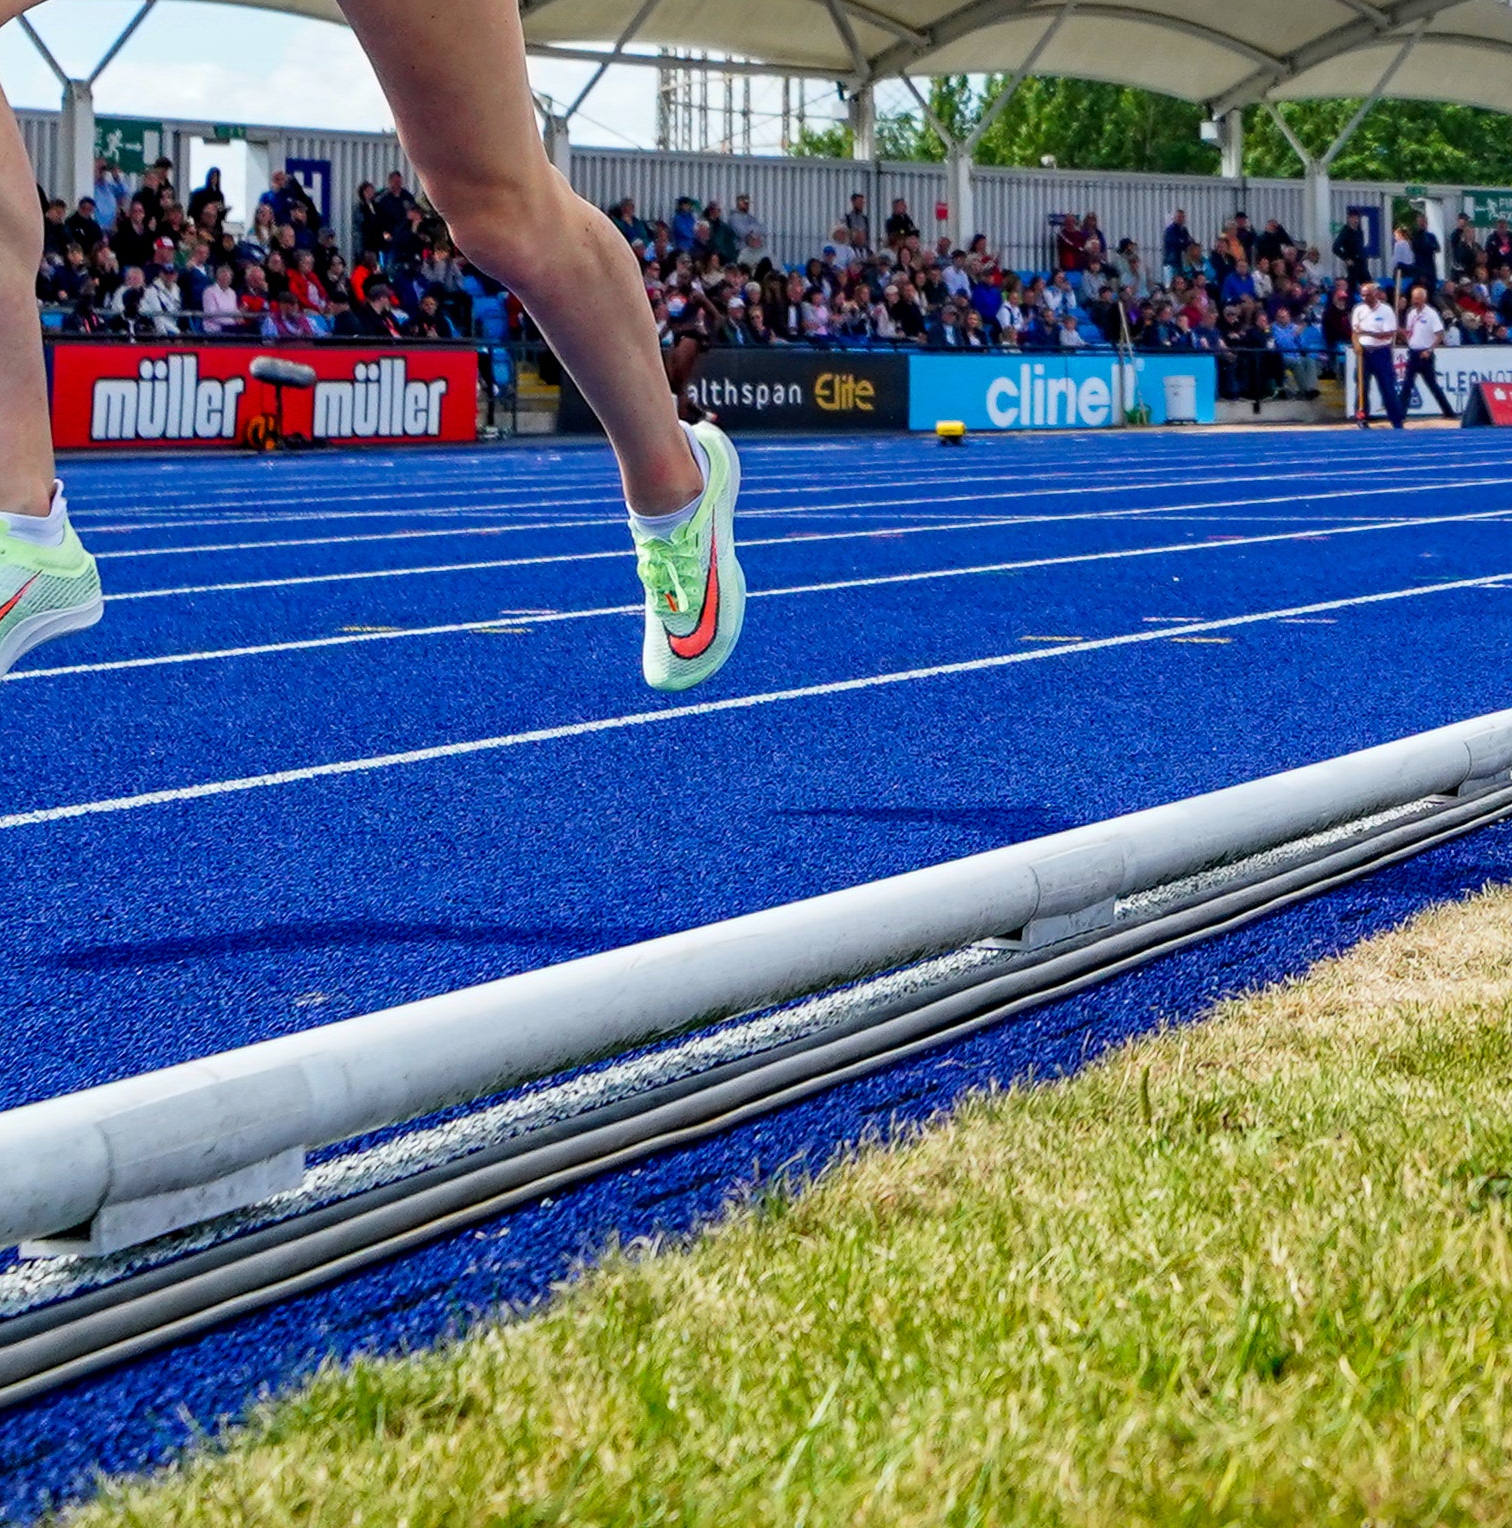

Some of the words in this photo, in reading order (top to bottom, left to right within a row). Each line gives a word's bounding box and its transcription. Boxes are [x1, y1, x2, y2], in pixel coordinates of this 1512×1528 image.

[91, 352, 245, 440] müller
[313, 355, 448, 438] müller
[814, 373, 876, 411] Elite
